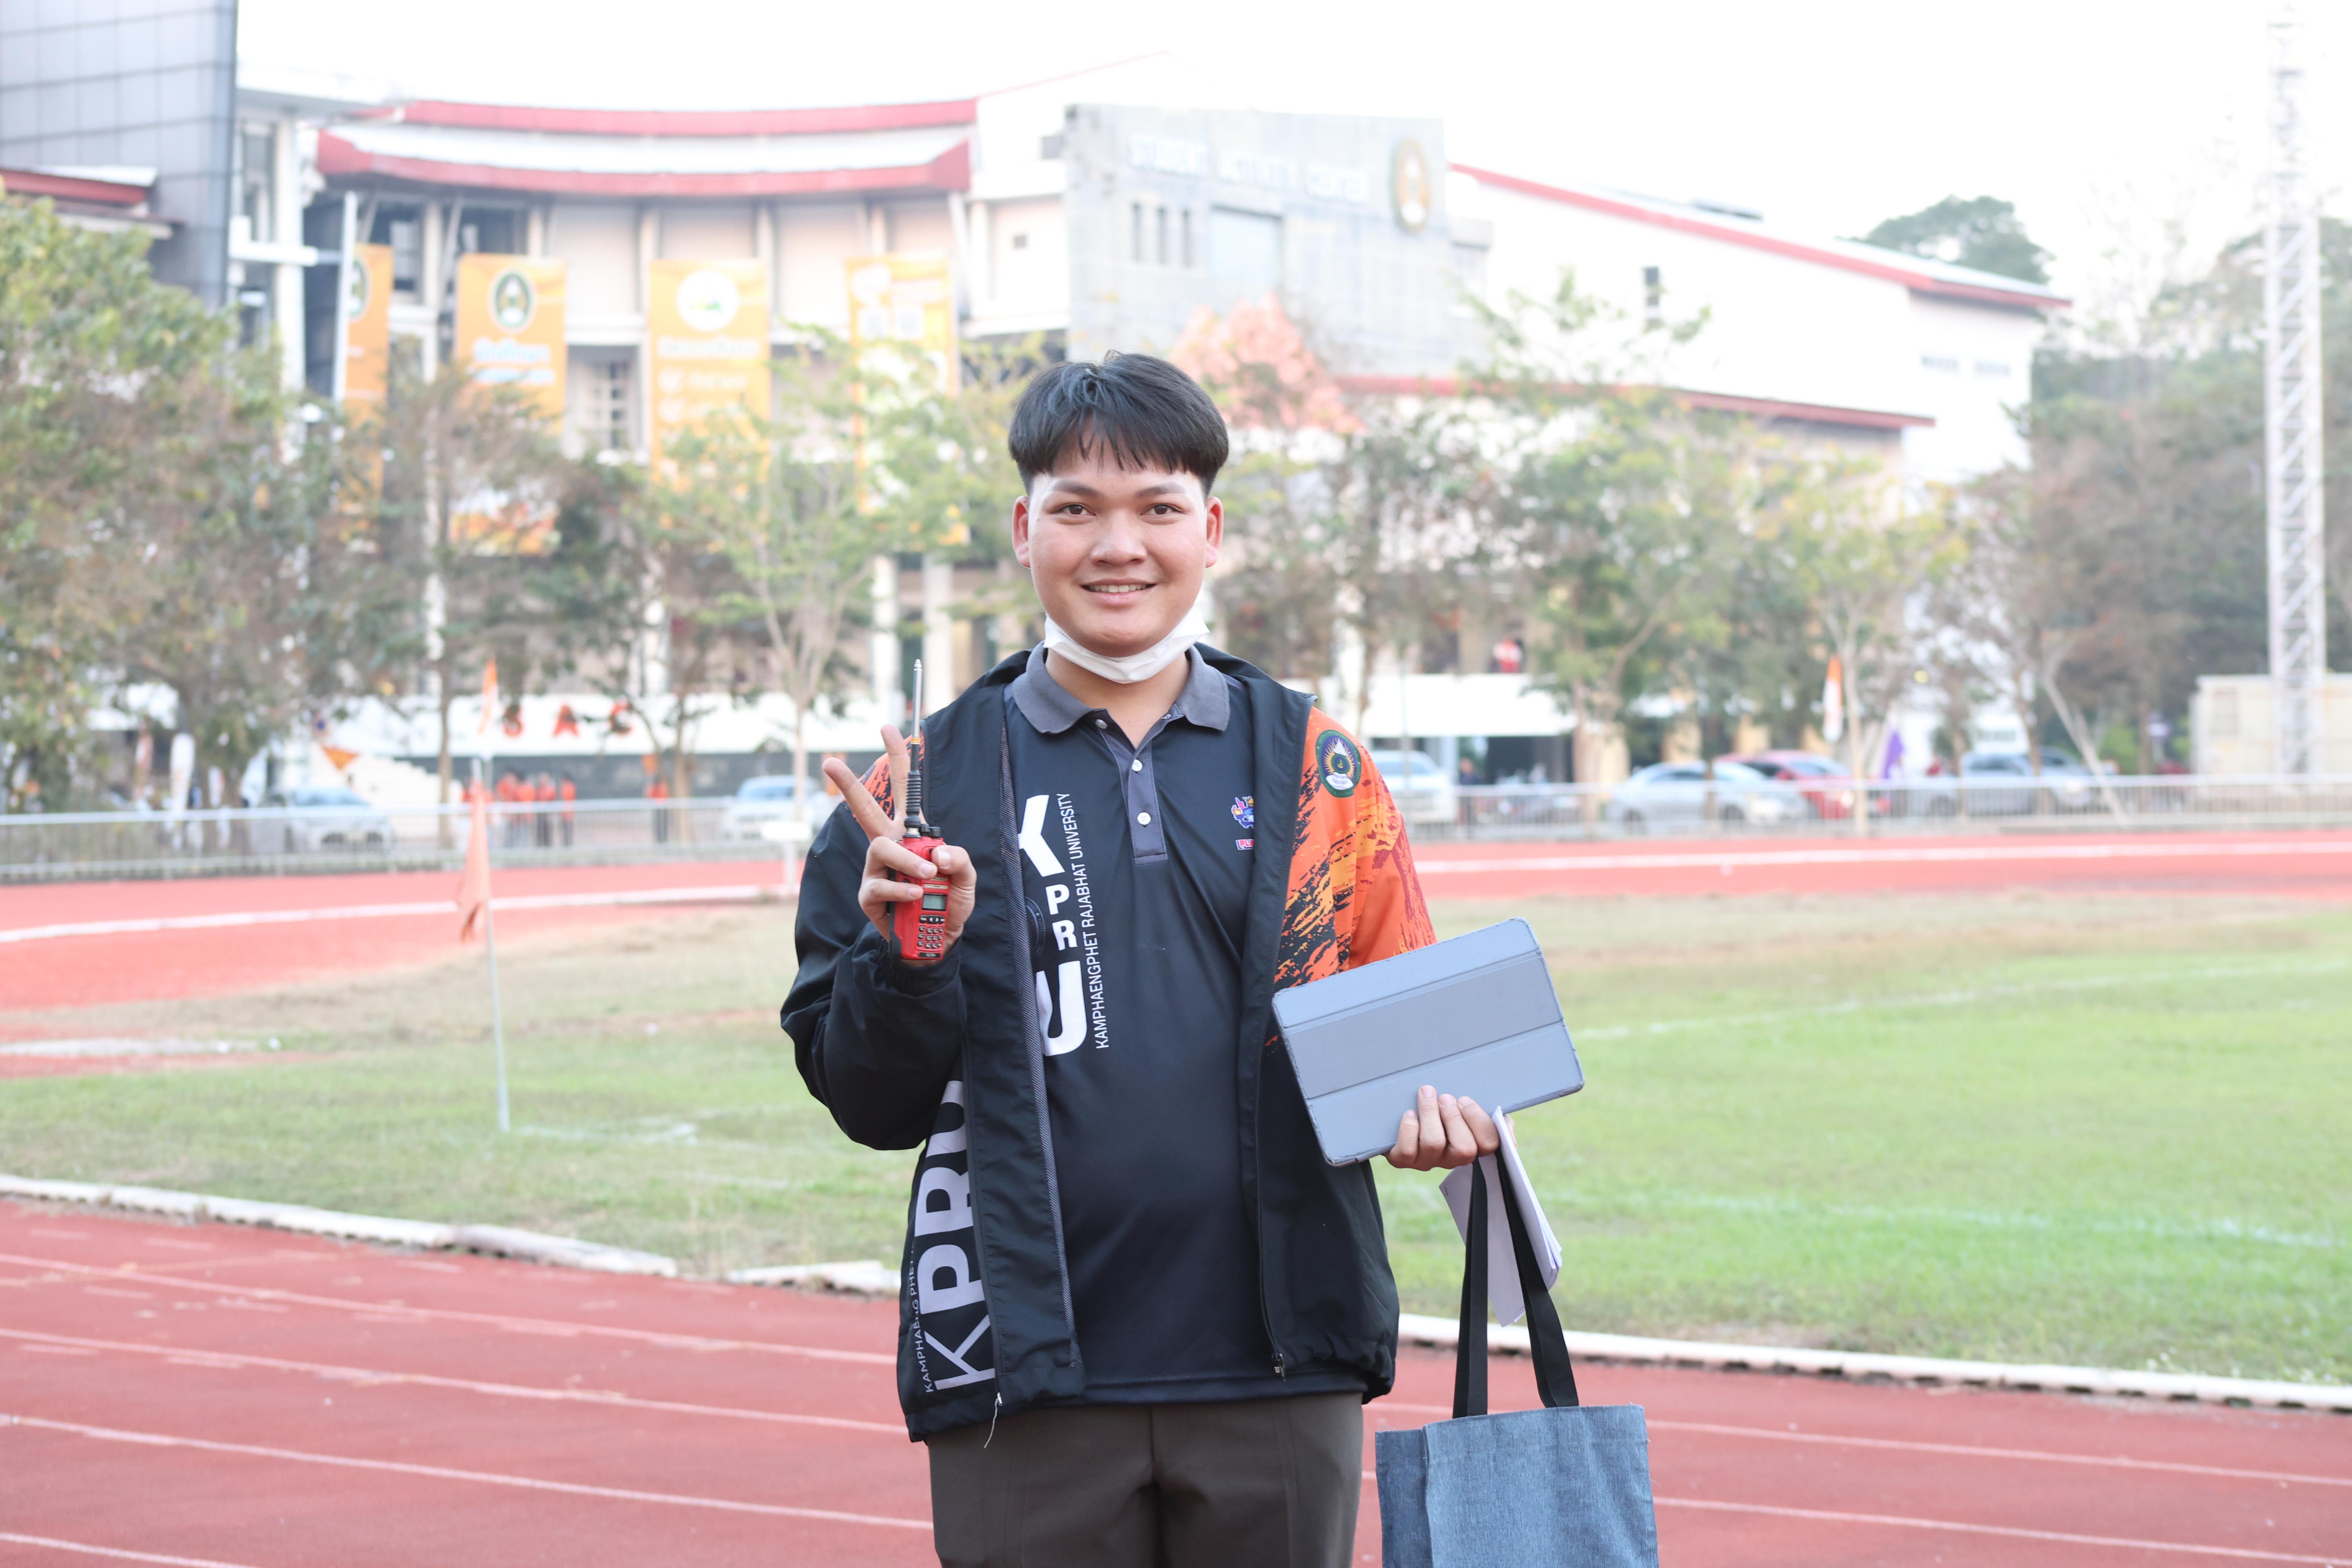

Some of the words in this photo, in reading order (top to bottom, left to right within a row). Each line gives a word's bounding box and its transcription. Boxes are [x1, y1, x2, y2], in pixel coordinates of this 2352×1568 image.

[1056, 793, 1083, 859] UNIVERSITY
[1071, 863, 1095, 928] RAJABHAT
[1082, 931, 1109, 1049] KAMPHAENGPHET
